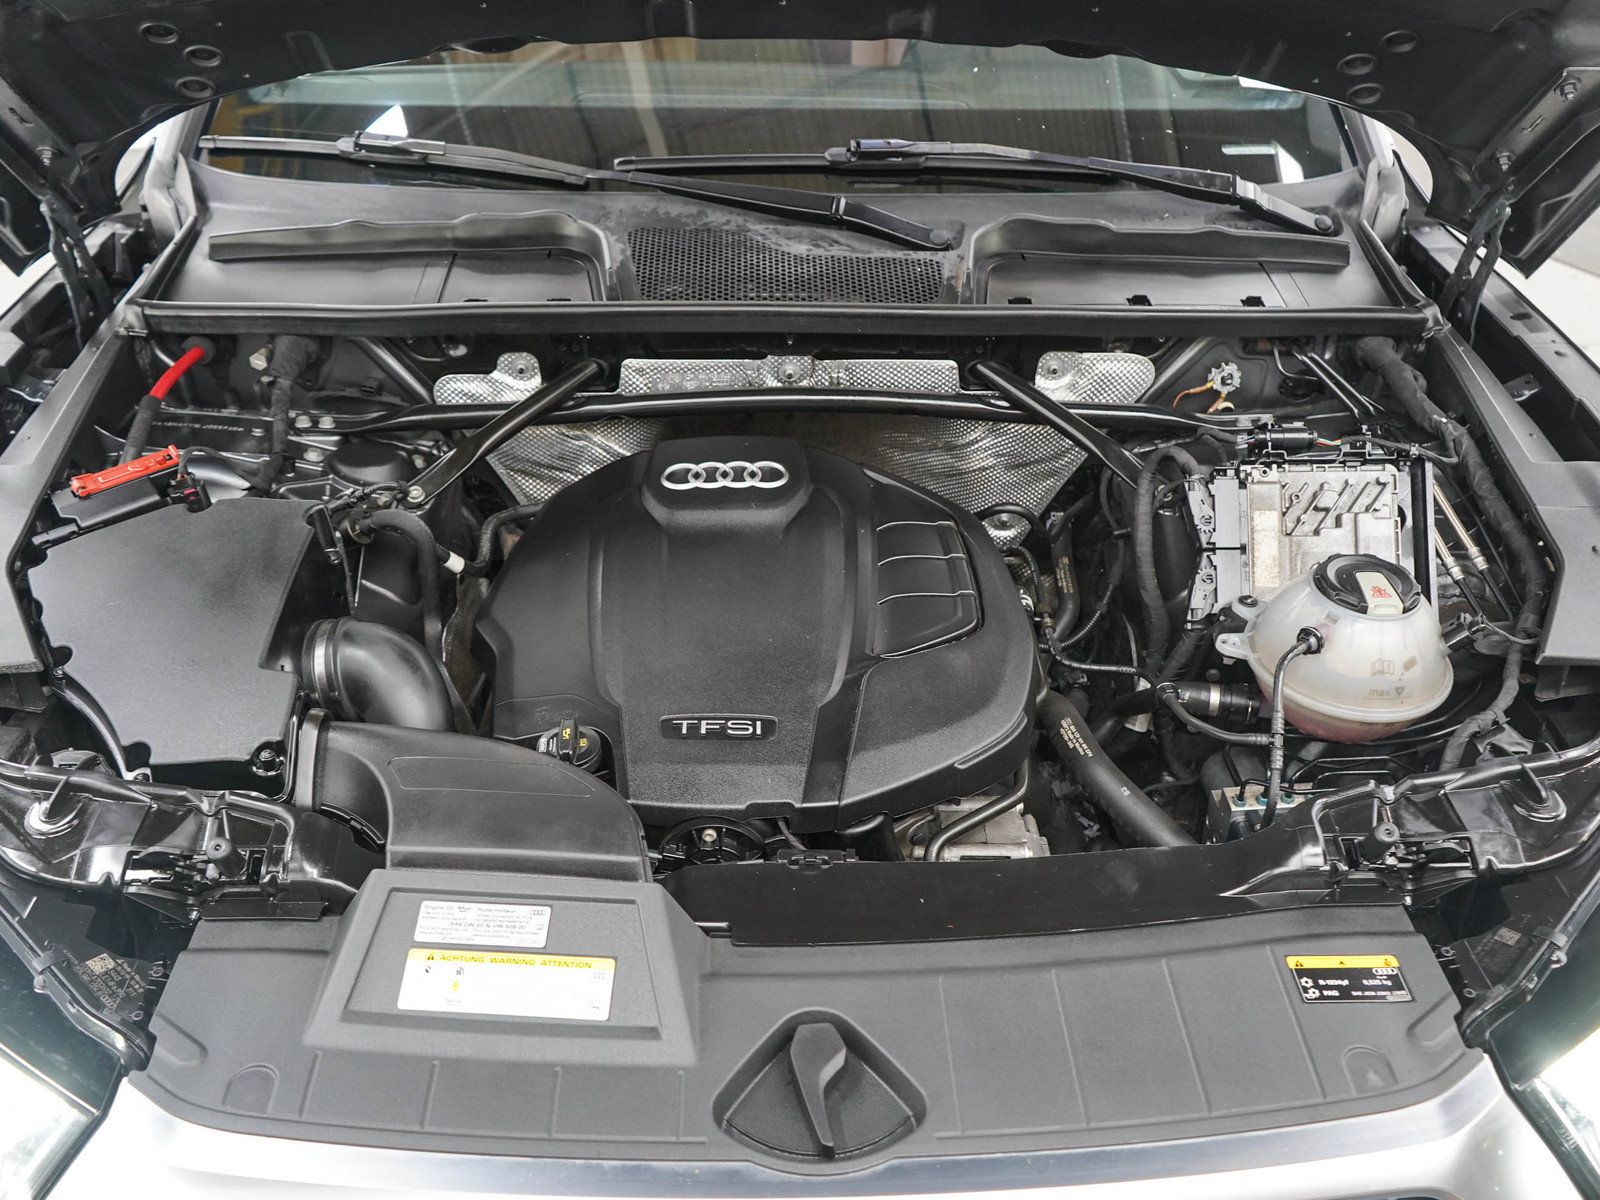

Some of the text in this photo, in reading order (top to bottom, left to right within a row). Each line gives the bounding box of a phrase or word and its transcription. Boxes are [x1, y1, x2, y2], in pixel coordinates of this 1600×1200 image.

[1368, 687, 1391, 697] max
[671, 719, 763, 736] TFSI
[439, 954, 593, 969] ACHTUNG WARNING ATTENTION
